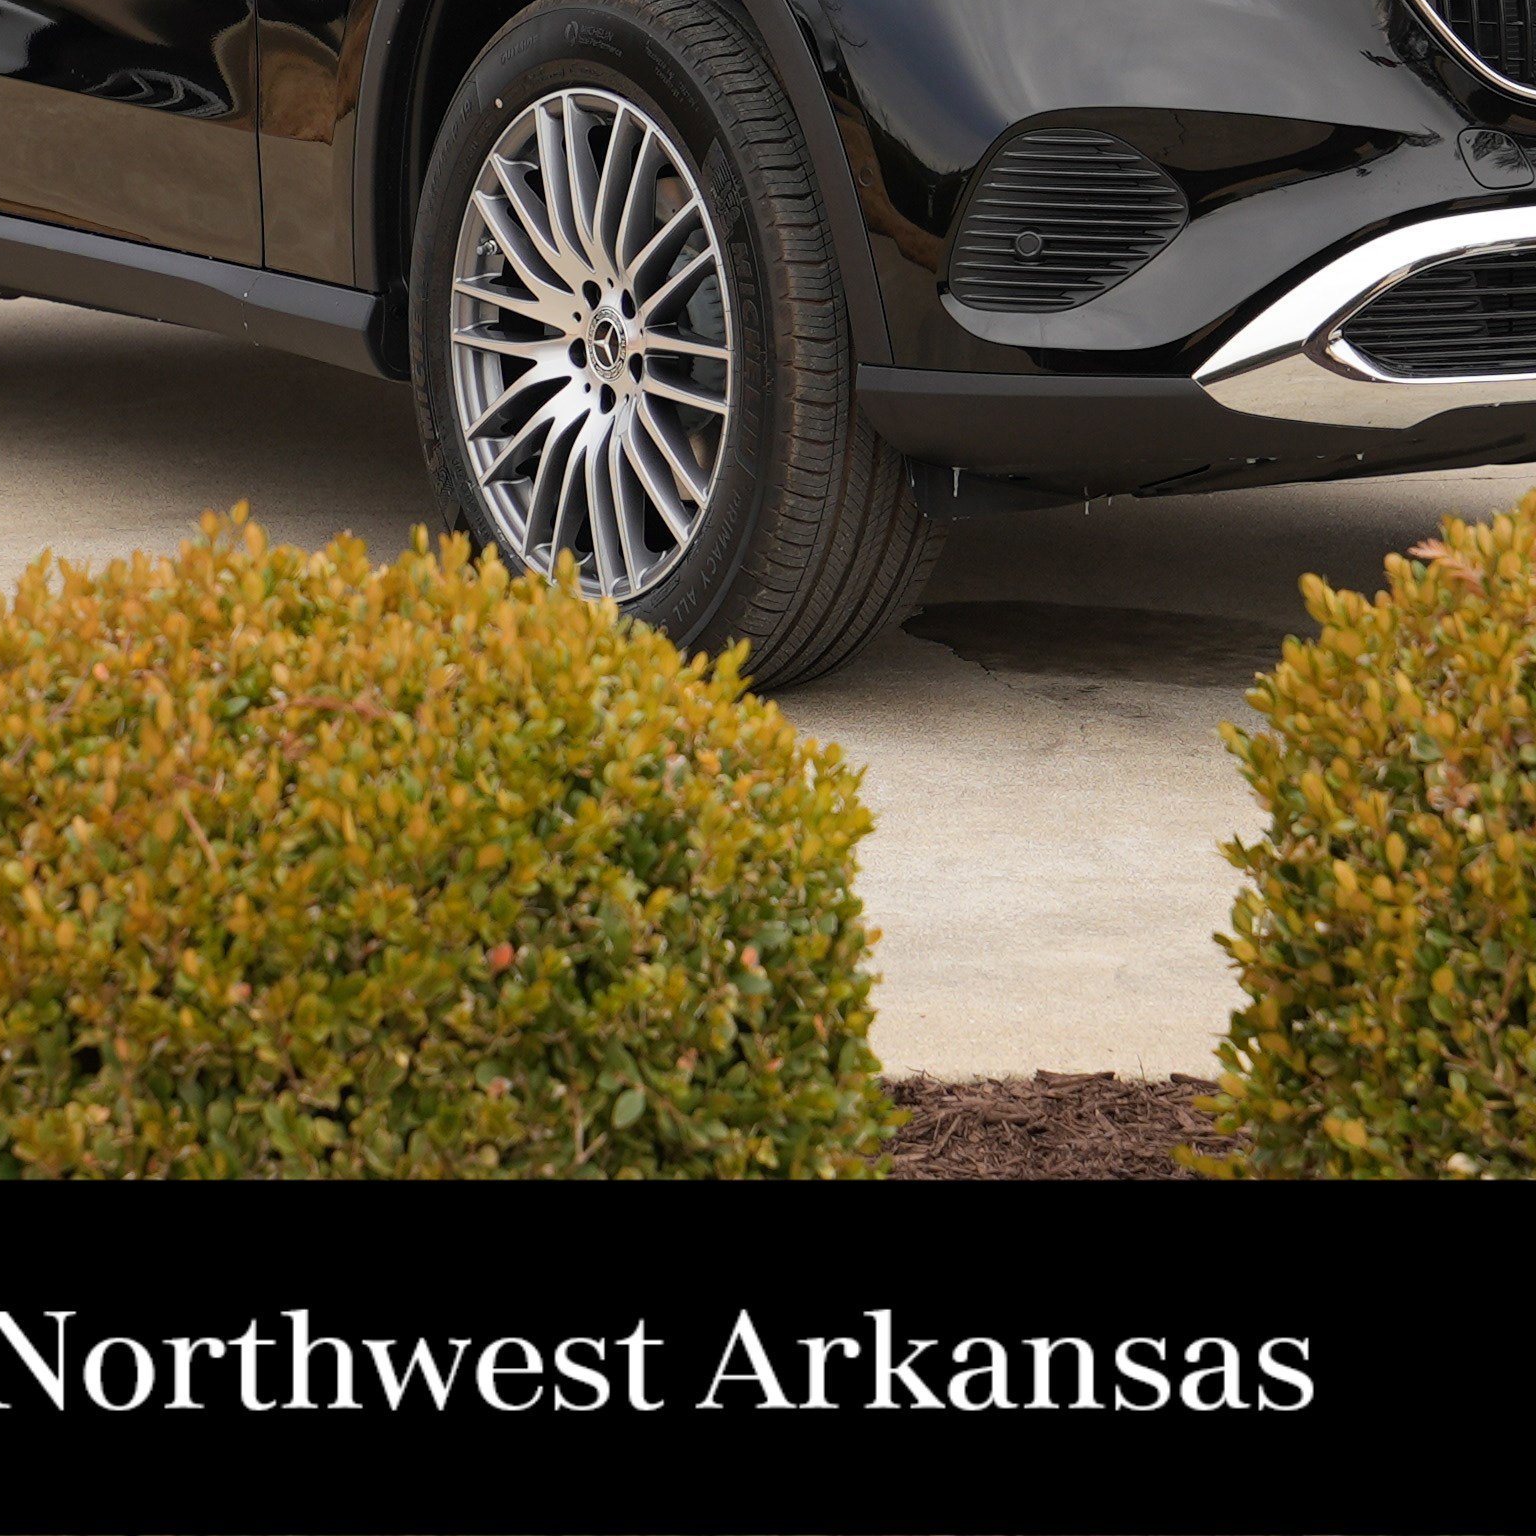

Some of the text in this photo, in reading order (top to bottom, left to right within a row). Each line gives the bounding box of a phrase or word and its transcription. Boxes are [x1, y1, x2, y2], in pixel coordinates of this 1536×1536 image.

[729, 242, 762, 458] MICHELIN
[671, 488, 743, 623] PRIMACY ALL
